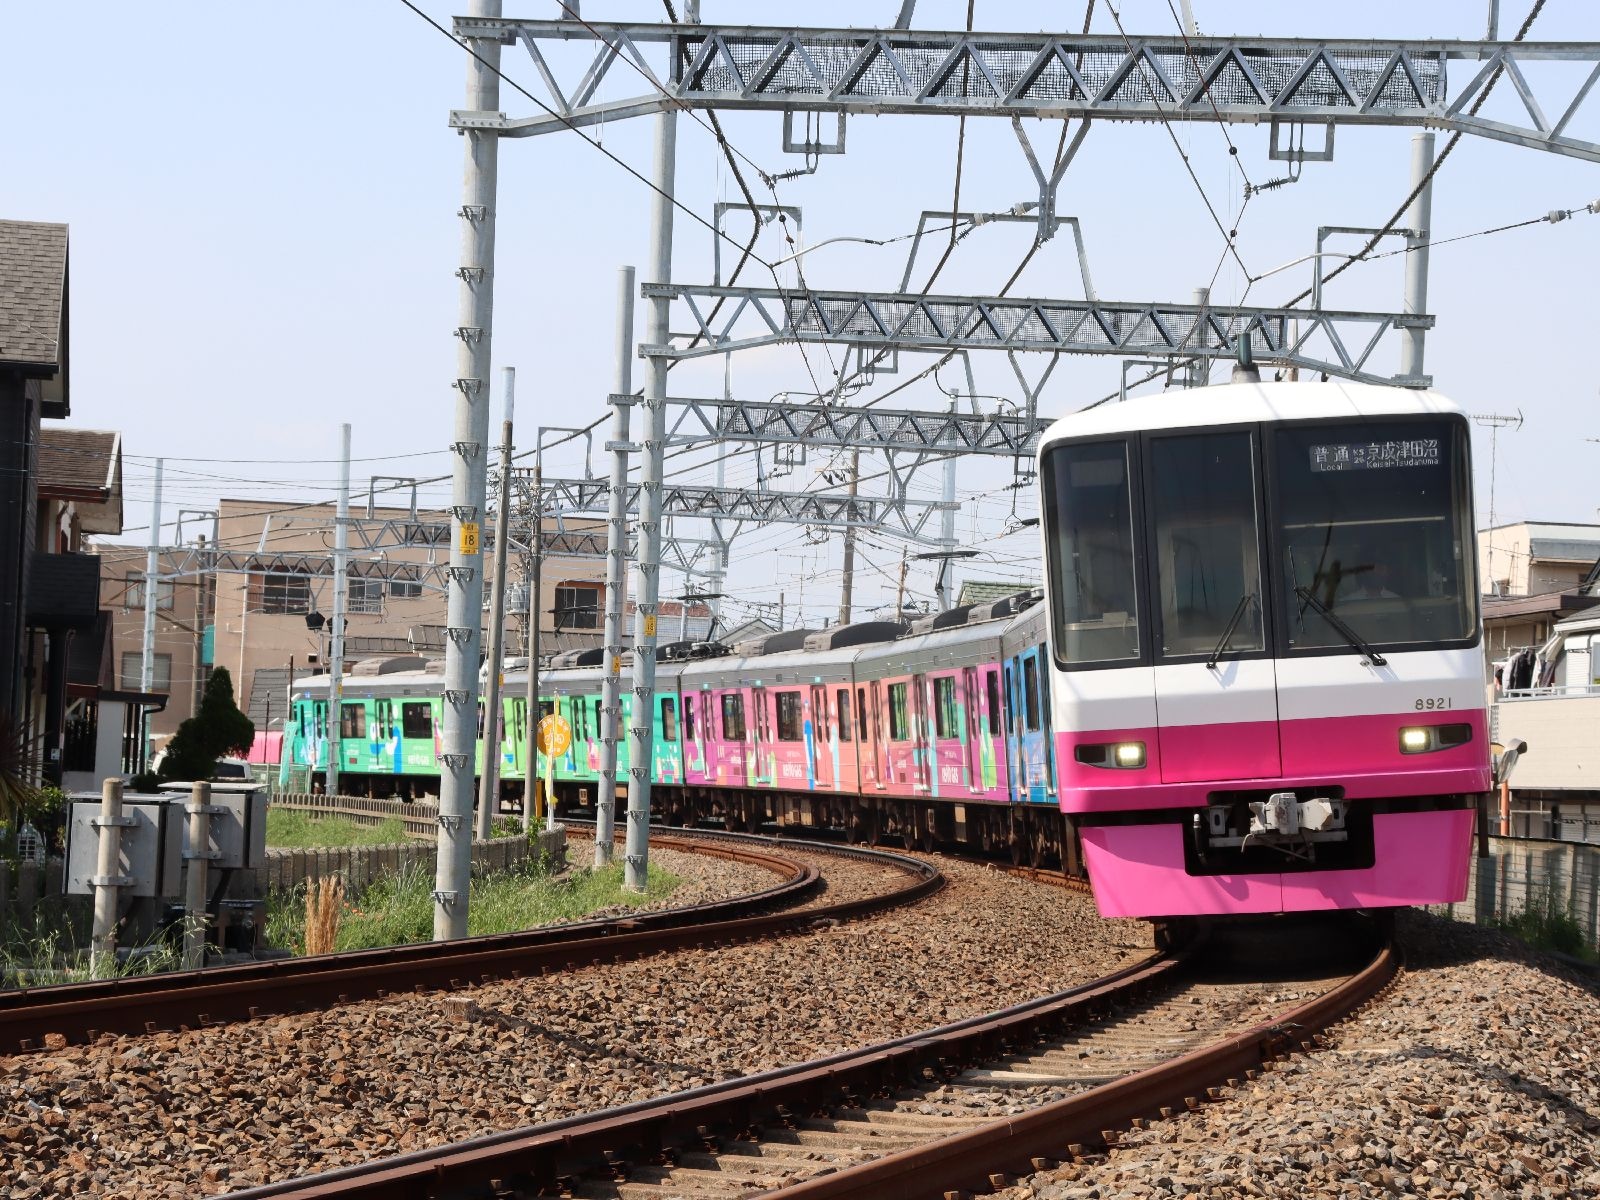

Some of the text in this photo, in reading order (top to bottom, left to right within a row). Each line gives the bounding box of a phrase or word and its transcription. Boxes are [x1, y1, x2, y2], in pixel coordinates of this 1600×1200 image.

[1314, 446, 1349, 463] 普通
[1366, 439, 1438, 461] 京成津田沼
[1320, 463, 1343, 471] Local
[1366, 458, 1439, 469] Keisei-Tsudanuma
[465, 534, 475, 546] 18
[1415, 697, 1451, 710] 8921
